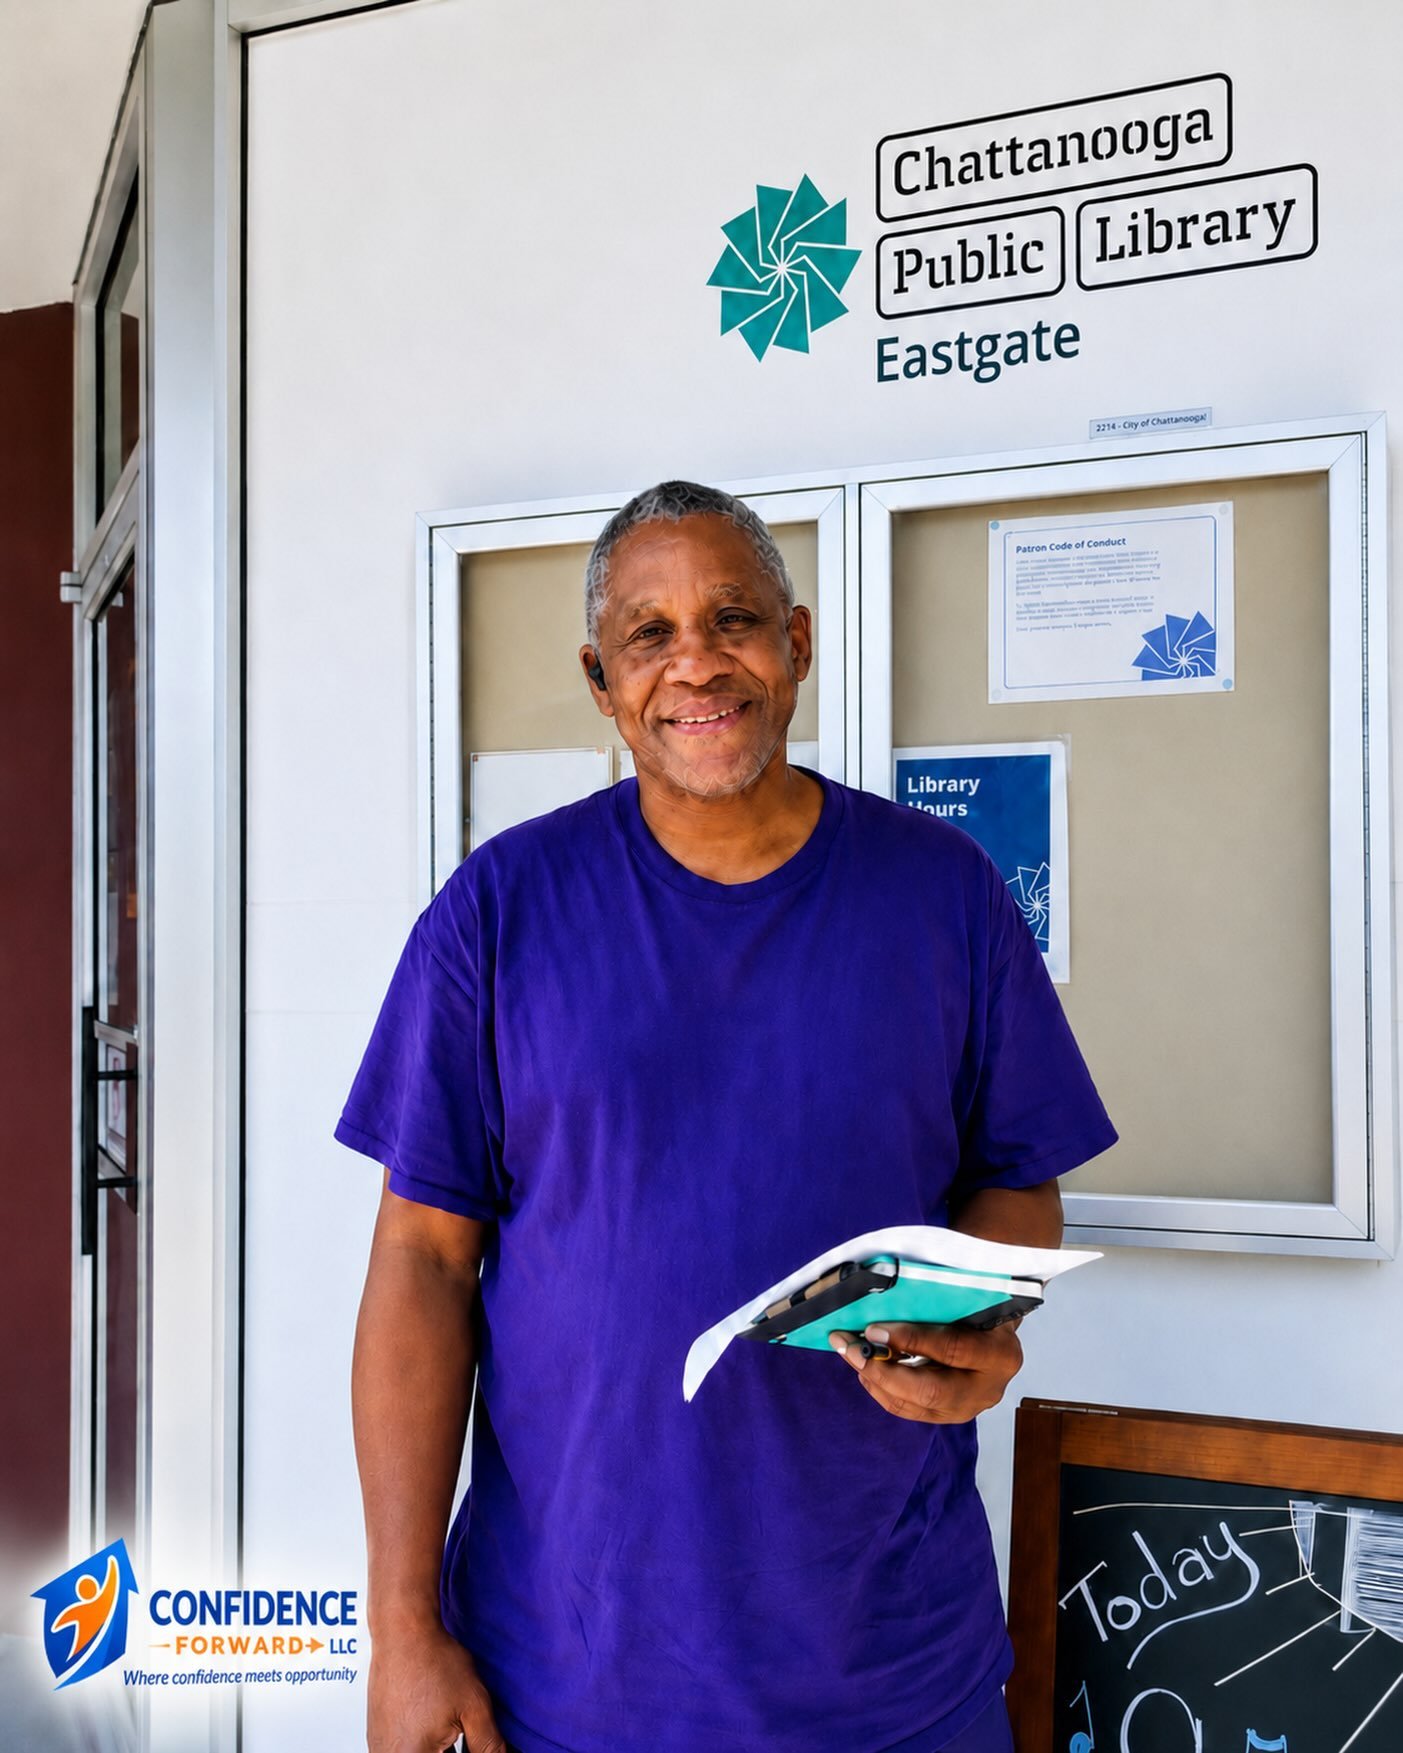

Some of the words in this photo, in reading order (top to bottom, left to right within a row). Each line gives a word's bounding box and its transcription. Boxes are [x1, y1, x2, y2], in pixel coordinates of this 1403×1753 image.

[893, 108, 1214, 197] Chattanooga
[893, 231, 1044, 295] Public
[1095, 198, 1297, 263] Library
[876, 320, 1081, 384] Eastgate
[1122, 420, 1140, 431] City
[1140, 418, 1150, 428] of
[1015, 544, 1048, 554] Patron
[1048, 542, 1073, 552] Code
[1074, 540, 1086, 549] of
[1086, 538, 1127, 549] Conduct
[907, 775, 981, 797] Library
[1058, 1521, 1261, 1670] Today
